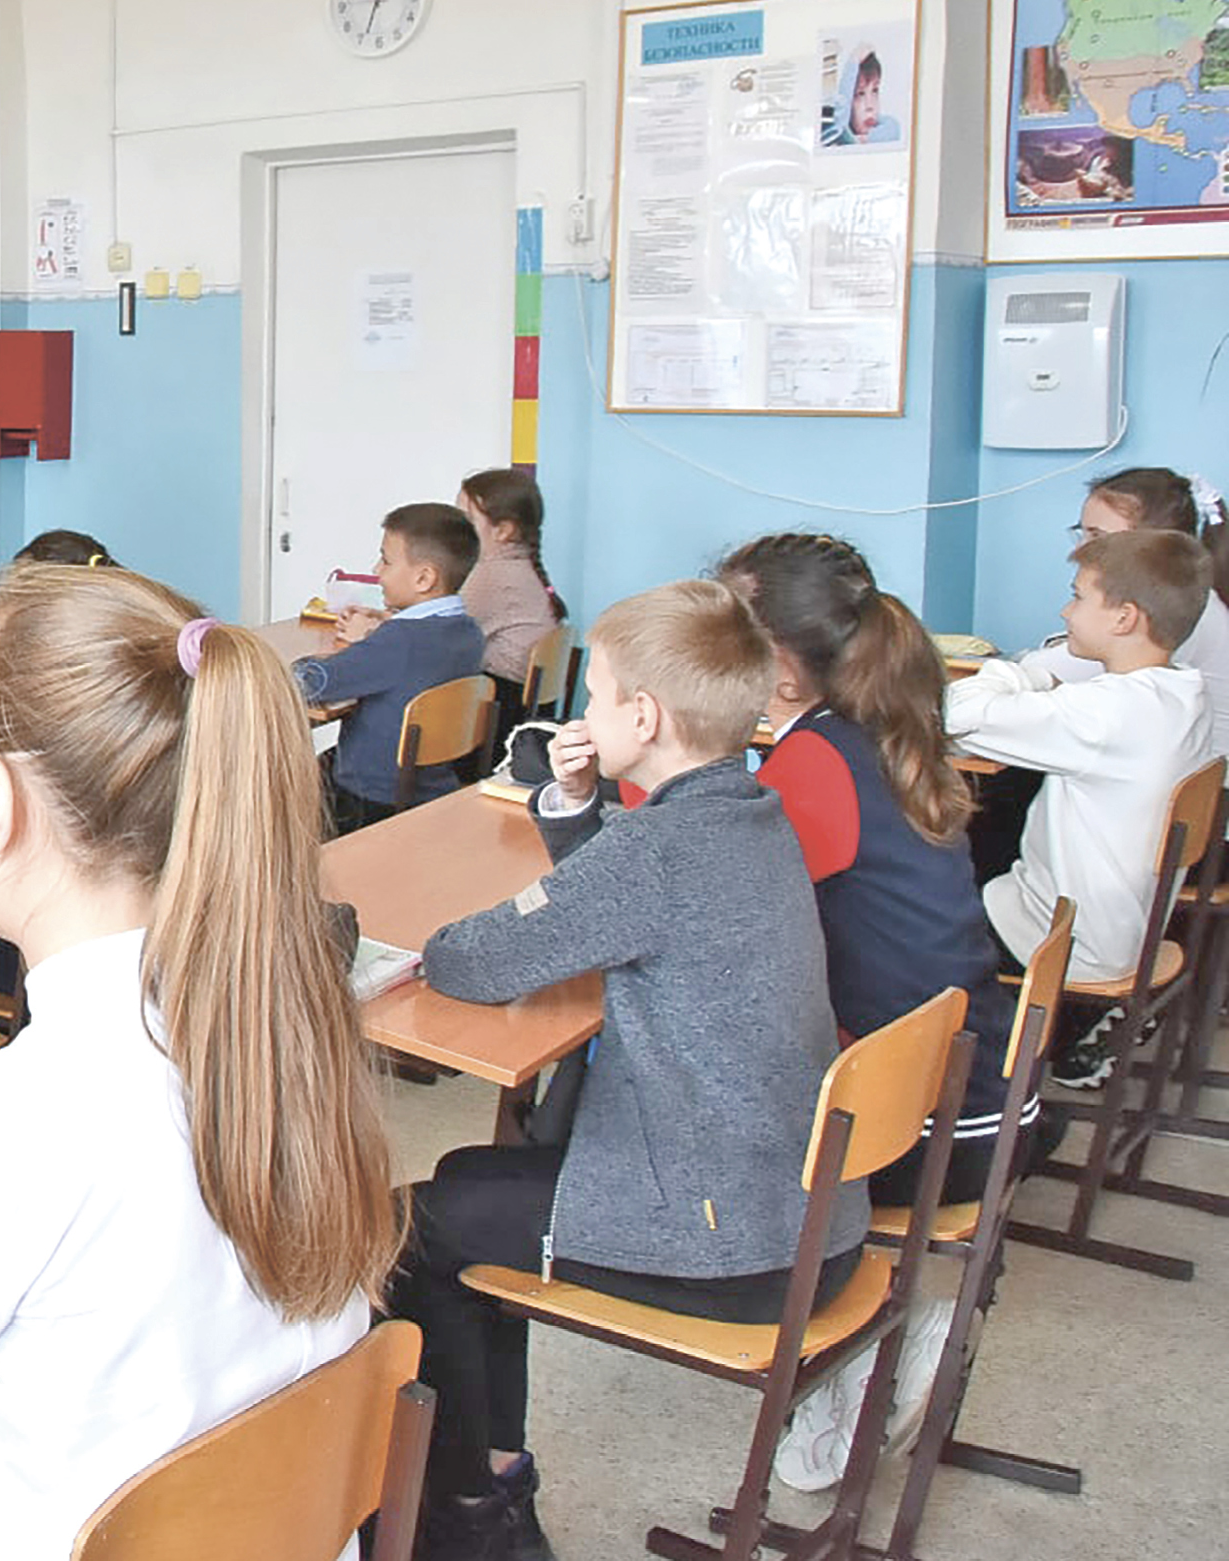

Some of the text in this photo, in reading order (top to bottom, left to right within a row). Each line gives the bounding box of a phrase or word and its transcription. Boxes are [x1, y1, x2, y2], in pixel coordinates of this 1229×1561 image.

[667, 20, 736, 39] ТЕХНИКА
[375, 35, 384, 49] 6
[643, 36, 761, 61] БЕЗОПАСНОСТИ
